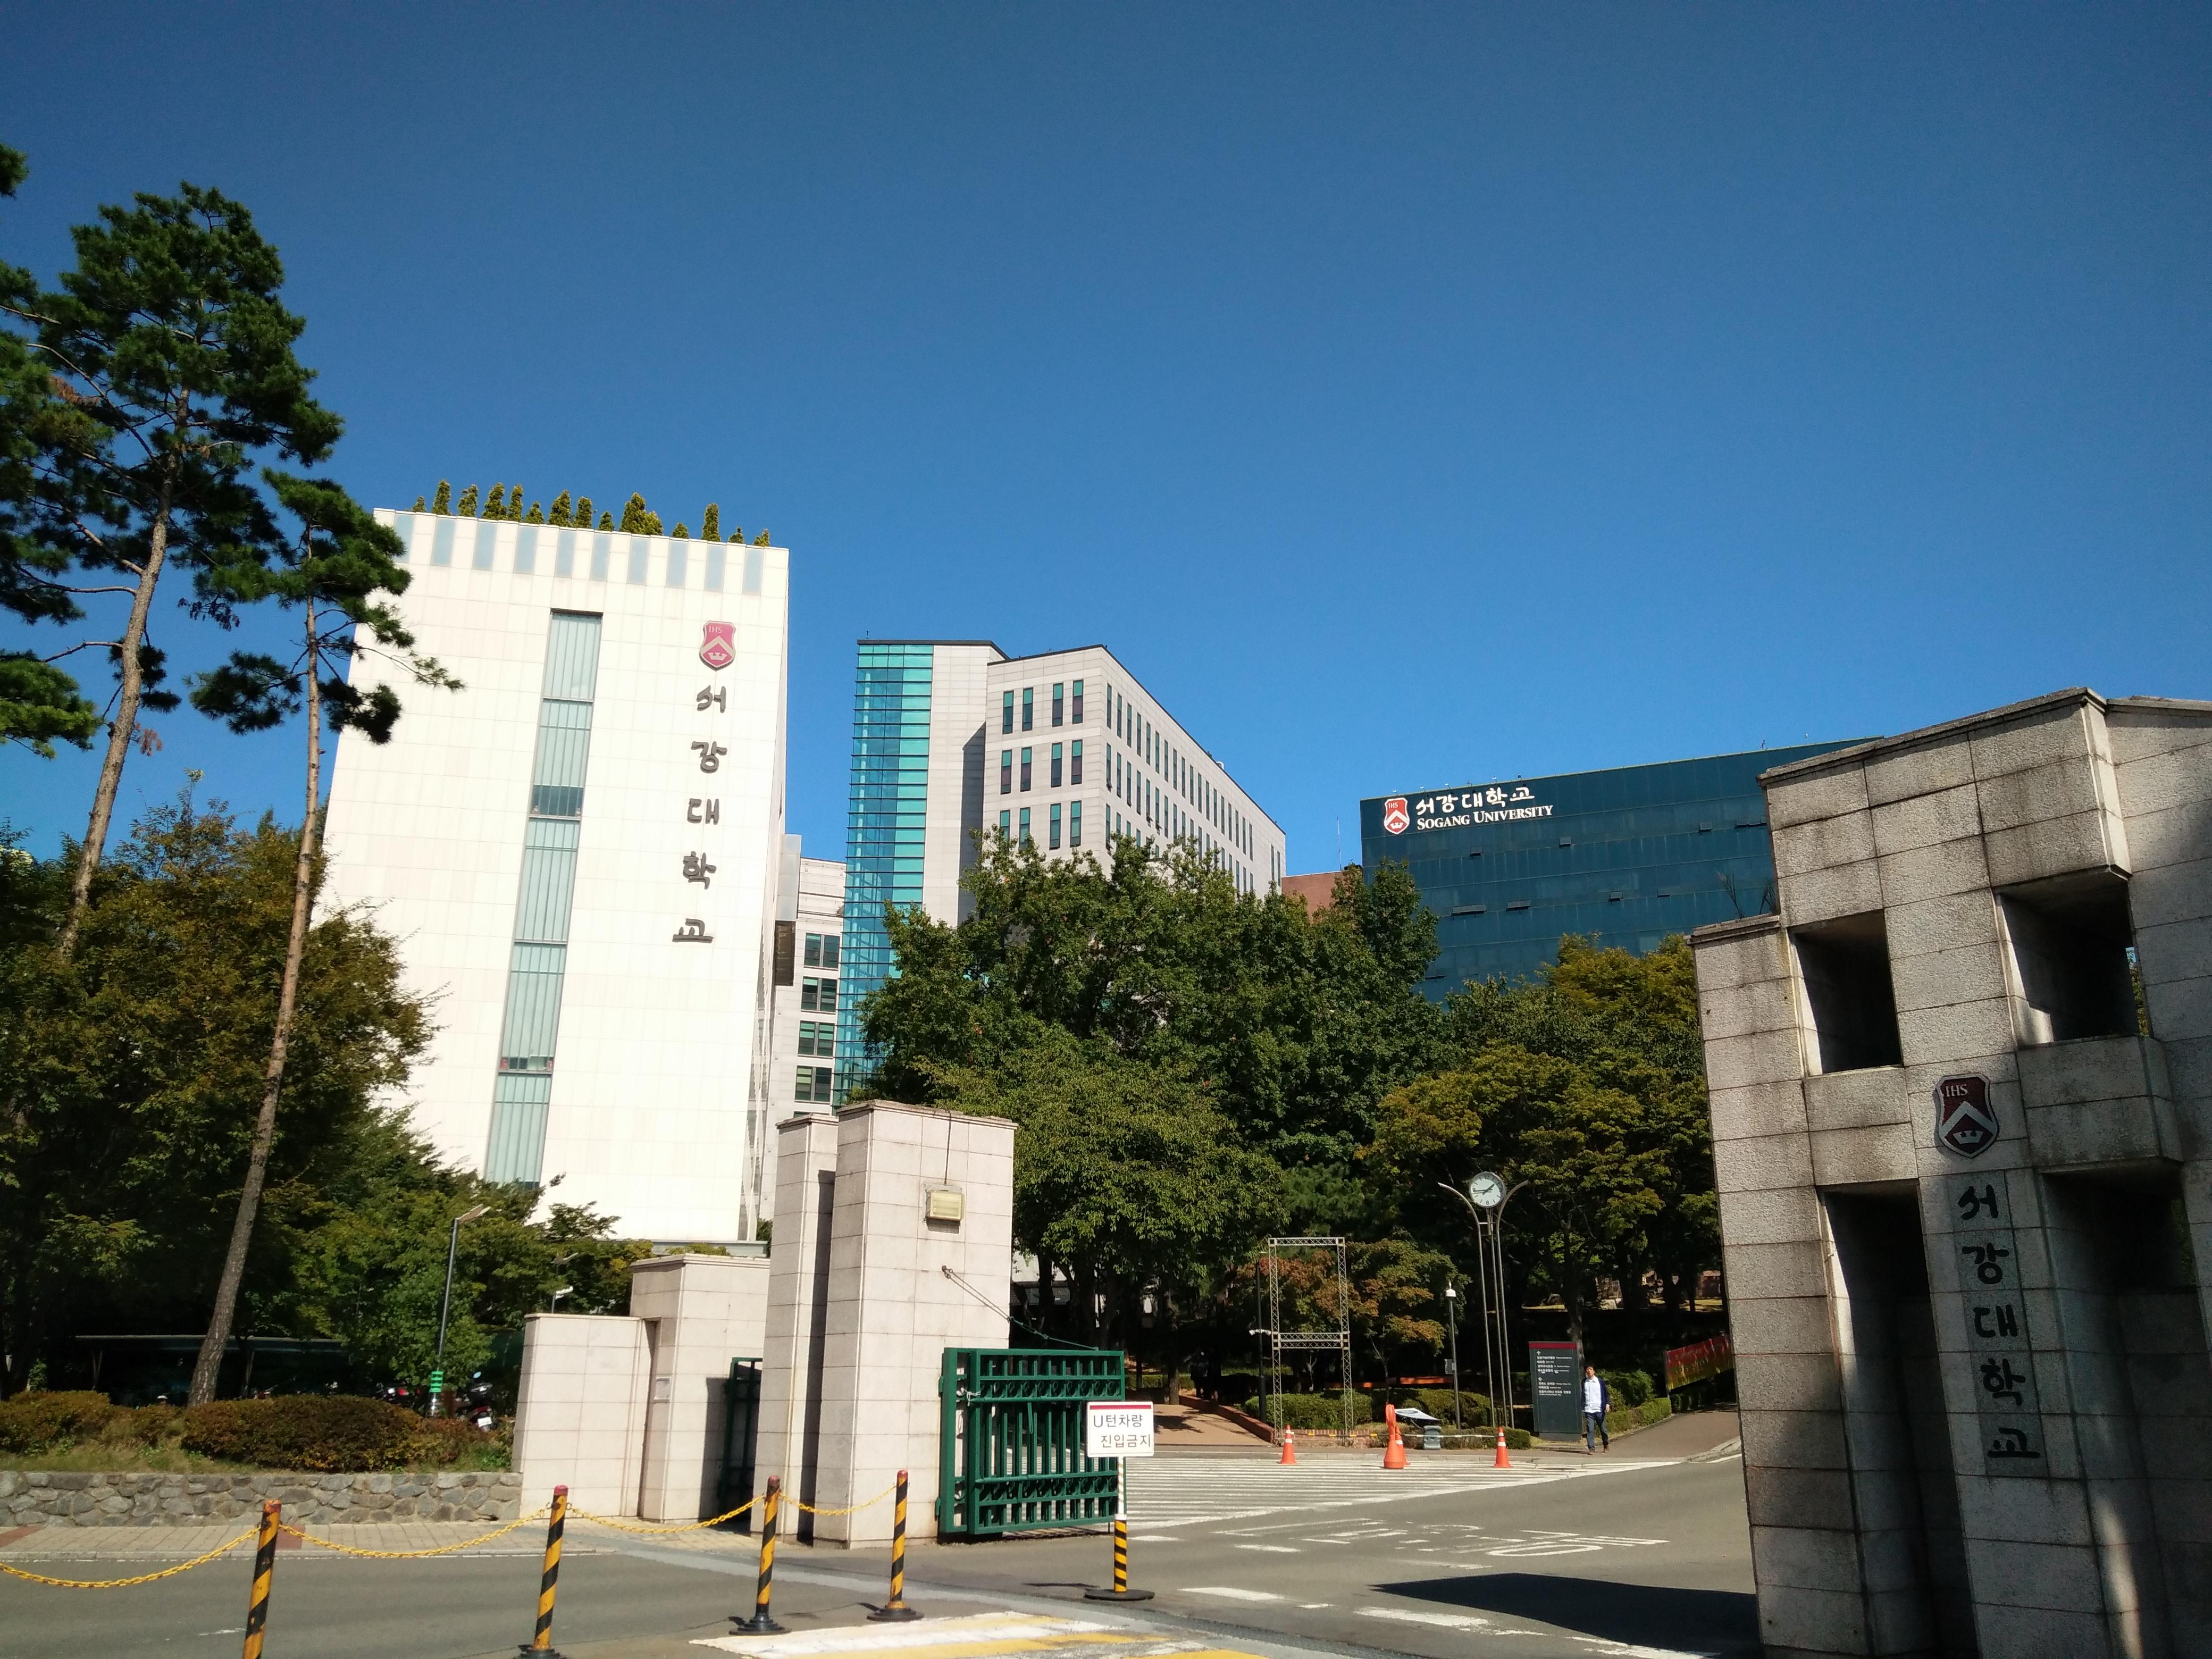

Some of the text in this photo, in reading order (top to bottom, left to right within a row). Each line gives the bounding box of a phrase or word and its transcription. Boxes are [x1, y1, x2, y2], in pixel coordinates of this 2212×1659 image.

[672, 685, 728, 943] 서강대학교
[1415, 786, 1535, 816] 서강대학교
[1417, 805, 1554, 831] SOGANG UNIVERSITY
[1945, 1083, 1968, 1097] IHS
[1957, 1184, 2041, 1459] 서강대학교
[1093, 1414, 1143, 1428] U턴차량
[1101, 1434, 1151, 1448] 진입금지
